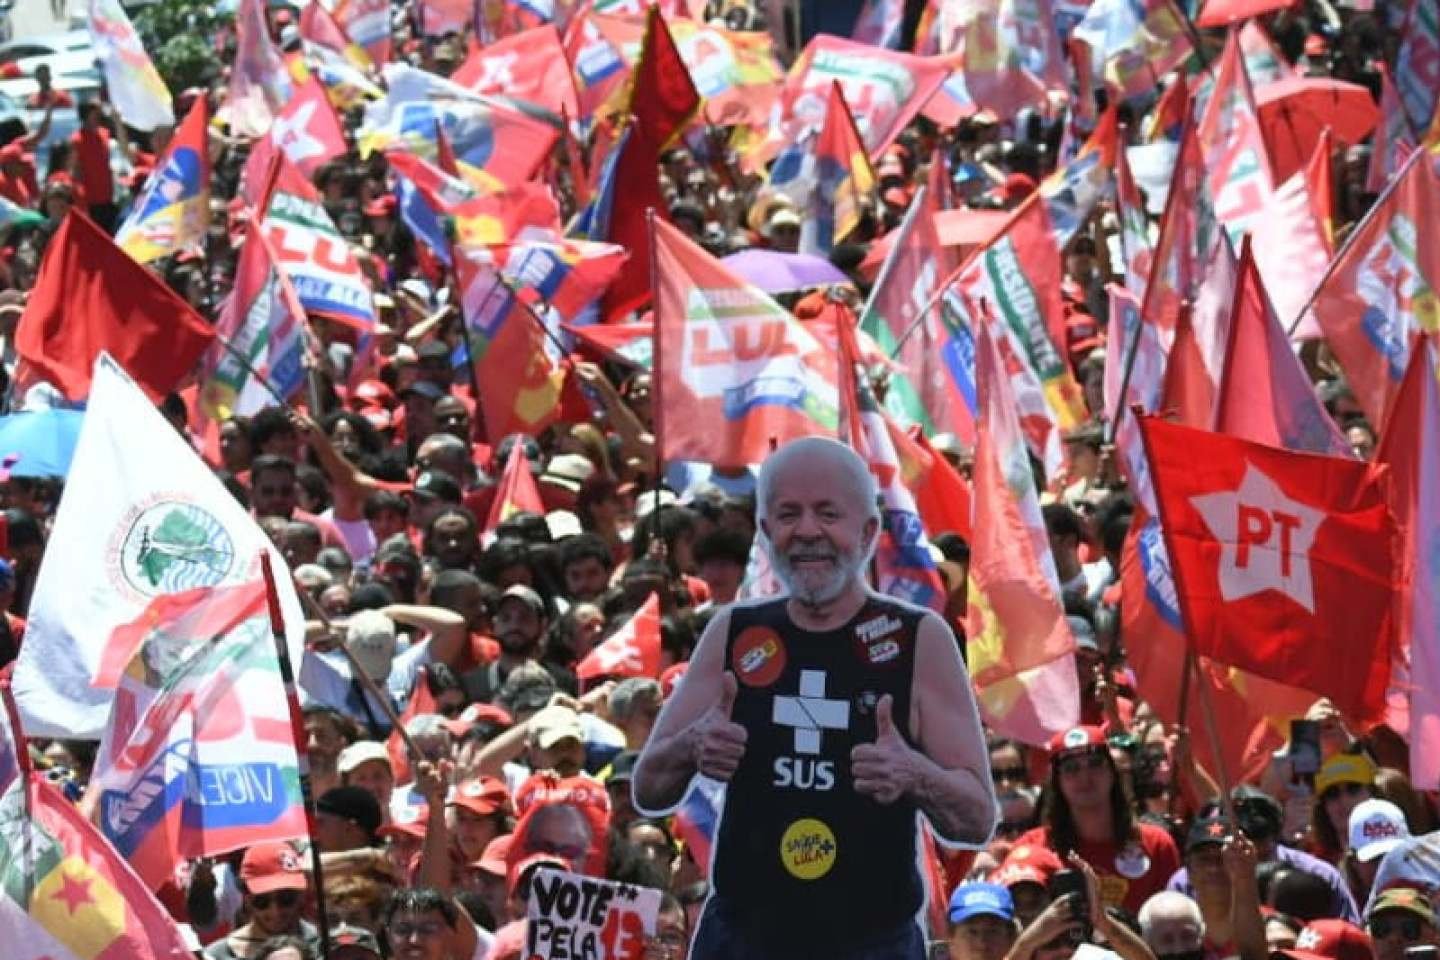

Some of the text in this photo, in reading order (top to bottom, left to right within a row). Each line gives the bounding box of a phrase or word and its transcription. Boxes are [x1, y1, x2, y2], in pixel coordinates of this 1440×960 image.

[1236, 503, 1303, 577] PT
[773, 756, 835, 791] SUS
[534, 876, 613, 926] VOTE
